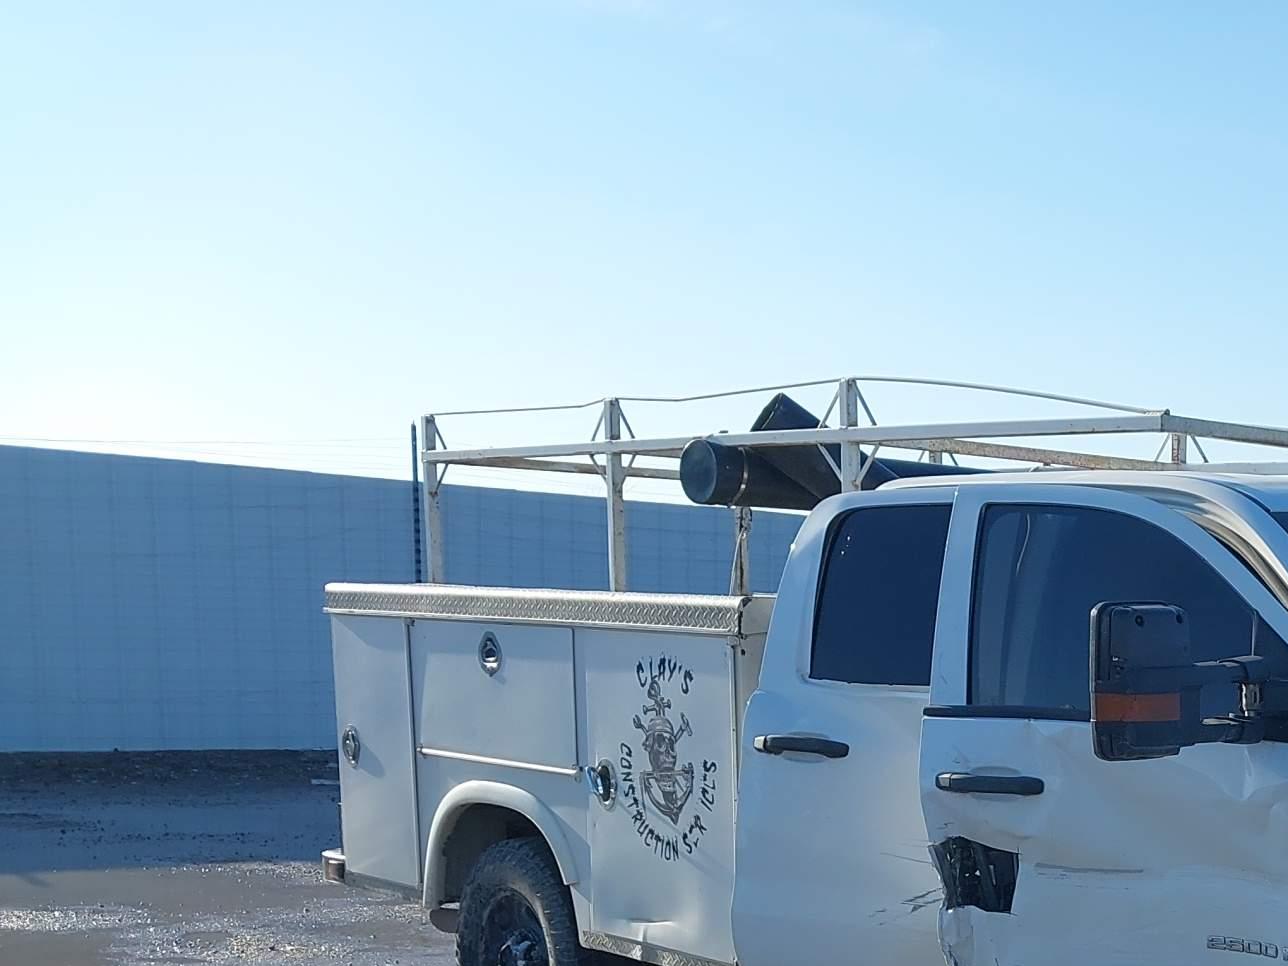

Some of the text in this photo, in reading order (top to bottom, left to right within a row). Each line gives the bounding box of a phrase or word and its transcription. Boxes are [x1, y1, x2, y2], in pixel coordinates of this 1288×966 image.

[636, 656, 694, 695] CLAY'S
[619, 742, 679, 862] CONSTRUCTION
[1207, 935, 1278, 959] 2500
